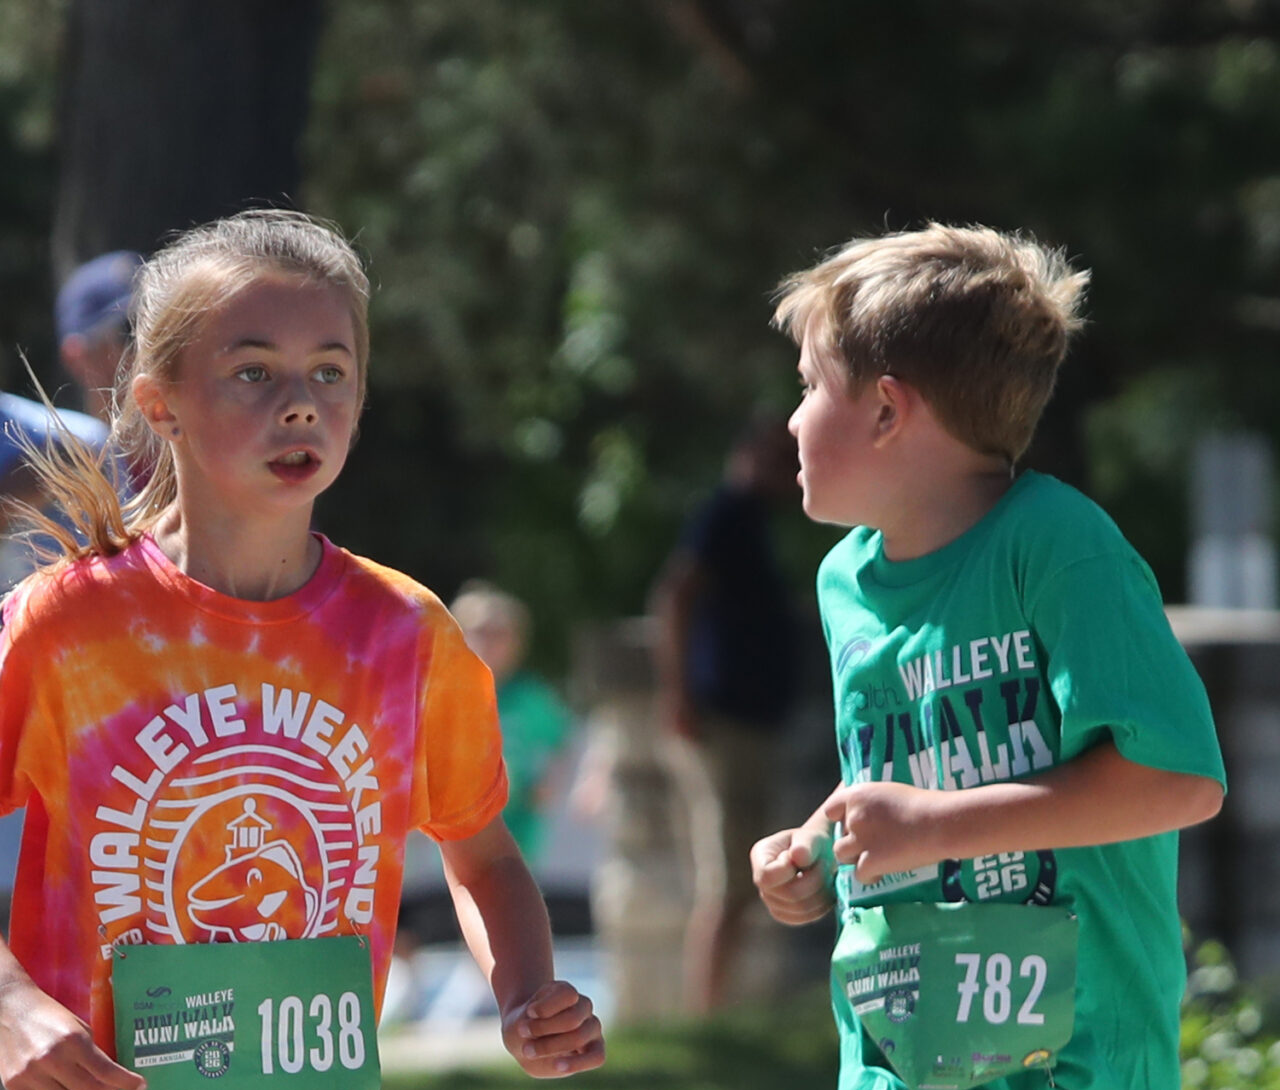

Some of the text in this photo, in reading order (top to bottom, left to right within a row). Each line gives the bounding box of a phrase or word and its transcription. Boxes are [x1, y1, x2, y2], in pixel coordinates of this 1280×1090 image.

[899, 630, 1035, 701] WALLEYE
[90, 683, 382, 924] WALLEYE WEEKEND
[975, 863, 1028, 900] 26
[185, 988, 235, 1009] WALLEYE
[955, 953, 1048, 1025] 782
[258, 992, 365, 1075] 1038
